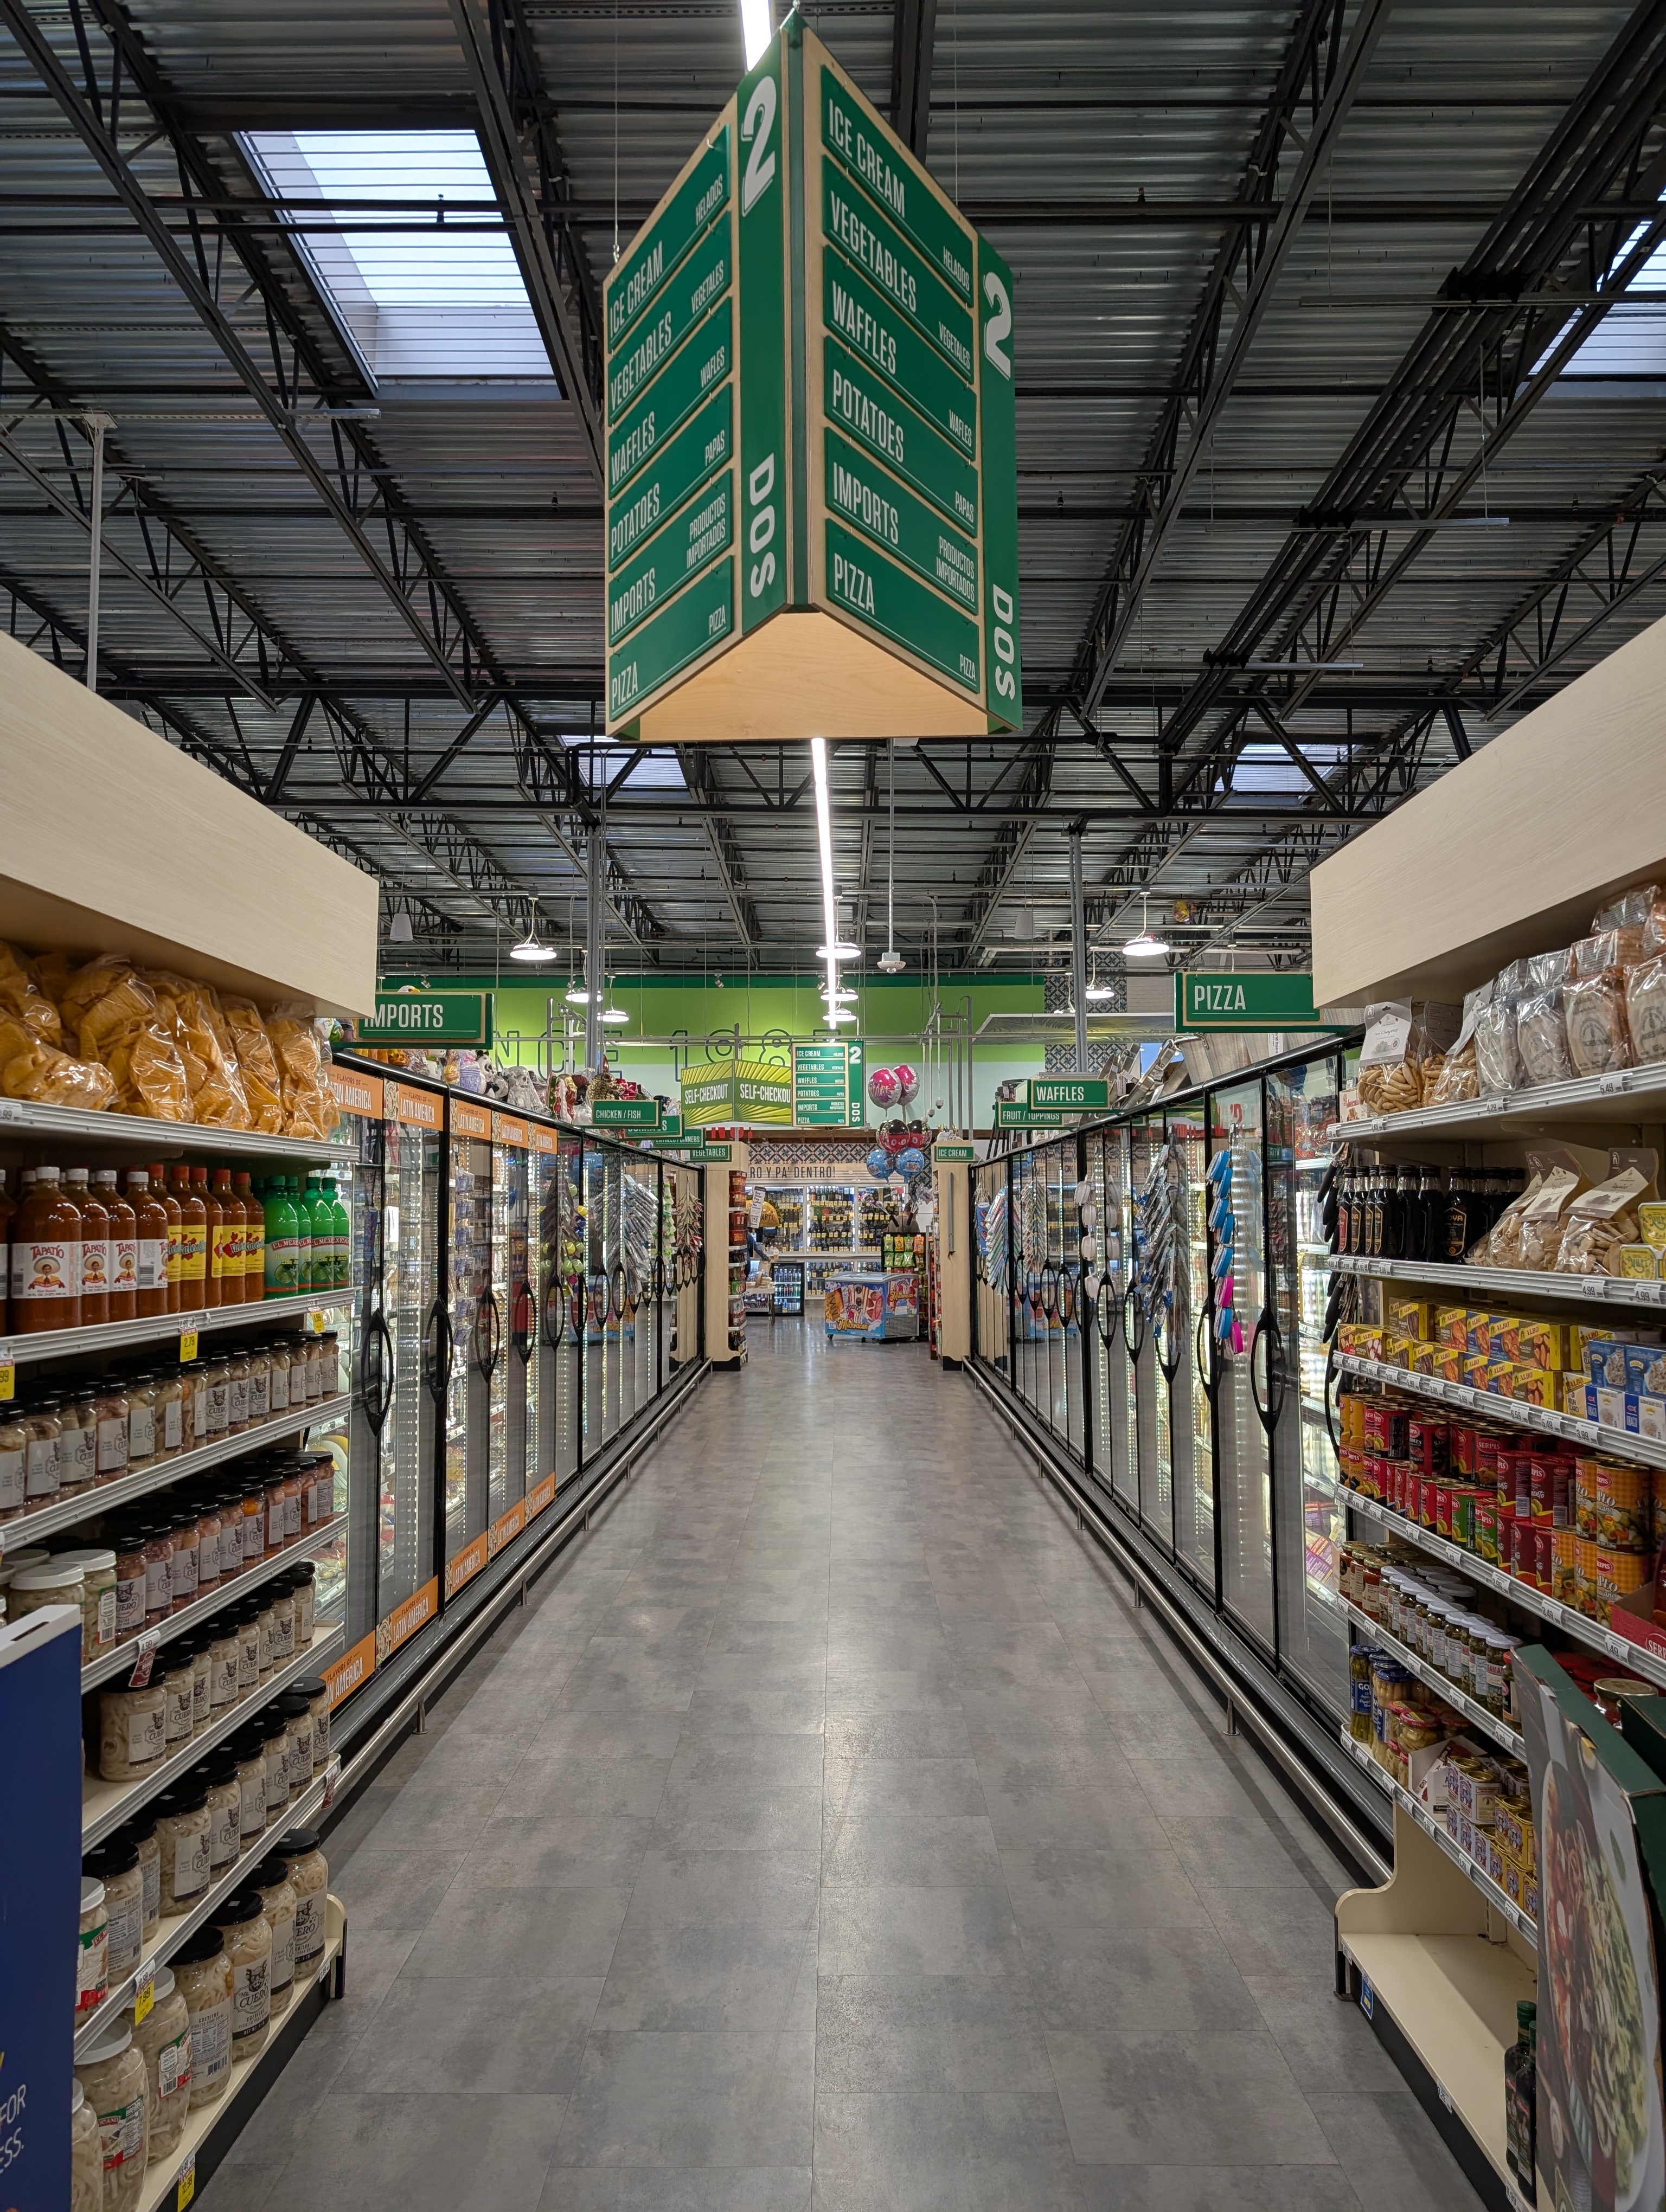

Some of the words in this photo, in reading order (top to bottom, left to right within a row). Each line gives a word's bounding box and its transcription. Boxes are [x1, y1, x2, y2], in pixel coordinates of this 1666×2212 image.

[741, 75, 776, 216] 2
[829, 99, 852, 159] ICE
[857, 133, 905, 218] CREAM
[696, 173, 722, 226] HELADOS
[830, 190, 917, 312] VEGETABLES
[943, 246, 970, 291] HELADOS
[611, 292, 625, 338] ICE
[627, 241, 663, 318] CREAM
[691, 260, 724, 314] VEGETALES
[832, 280, 896, 376] WAFFLES
[984, 272, 1011, 379] 2
[939, 321, 970, 369] VEGETALES
[611, 311, 671, 411] VEGETABLES
[700, 346, 725, 388] WAFLES
[832, 369, 904, 464] POTATOES
[949, 409, 972, 448] WAFLES
[611, 411, 655, 485] WAFFLES
[705, 430, 725, 466] PAPAS
[833, 461, 899, 545] IMPORTS
[955, 491, 974, 523] PAPAS
[611, 482, 659, 563] POTATOES
[689, 492, 725, 543] PRODUCTOS
[749, 453, 775, 598] DOS
[687, 519, 726, 569] IMPORTADOS
[939, 536, 975, 580] PRODUCTOS
[834, 552, 875, 616] PIZZA
[935, 557, 975, 602] IMPORTADOS
[611, 567, 655, 635] IMPORTS
[709, 605, 726, 635] PIZZA
[993, 583, 1015, 700] DOS
[959, 654, 976, 681] PIZZA
[612, 661, 638, 711] PIZZA
[1195, 985, 1246, 1010] PIZZA
[849, 1046, 861, 1064] 2
[337, 1073, 355, 1085] FLAVORS
[1600, 1083, 1614, 1094] 5.49
[345, 1086, 371, 1111] AMERICA
[408, 1092, 422, 1102] FLAVORS
[685, 1083, 728, 1105] SELF-CHECKOUT
[740, 1083, 792, 1104] SELF-CHECKOU
[1036, 1086, 1084, 1101] WAFFLES
[400, 1098, 413, 1118] LATIN
[414, 1103, 435, 1124] AMERICA
[596, 1110, 622, 1119] CHICKEN
[627, 1110, 641, 1119] FISH
[851, 1102, 860, 1122] DOS
[1003, 1111, 1022, 1120] FRUIT
[1486, 1103, 1497, 1113] 4.29
[692, 1148, 726, 1157] VEGETABLES
[766, 1167, 772, 1179] Y
[776, 1167, 790, 1179] PA'
[794, 1166, 835, 1178] DENTRO!
[1582, 1285, 1595, 1296] 4.99
[1635, 1290, 1650, 1301] 4.99
[1447, 1313, 1458, 1321] ALBO
[1471, 1317, 1481, 1326] ALBO
[1496, 1322, 1510, 1331] ALBO
[184, 1336, 195, 1348] 2.79
[1341, 1326, 1351, 1335] ALBO
[1362, 1333, 1374, 1341] ALBO
[1526, 1327, 1539, 1336] ALBO
[1585, 1330, 1599, 1341] ALBO
[1469, 1359, 1479, 1368] ALBO
[1494, 1365, 1505, 1374] ALBO
[1520, 1372, 1533, 1381] ALBO
[1541, 1419, 1553, 1430] 5.49
[1576, 1429, 1590, 1441] 3.99
[497, 1527, 505, 1546] LATIN
[506, 1514, 520, 1539] AMERICA
[453, 1567, 463, 1587] LATIN
[463, 1549, 480, 1580] AMERICA
[401, 1598, 415, 1617] FLAVORS
[416, 1595, 420, 1604] OF
[1542, 1606, 1554, 1620] 3.49
[393, 1617, 407, 1644] LATIN
[408, 1597, 428, 1632] AMERICA
[1606, 1642, 1619, 1657] 1.49
[327, 1664, 345, 1682] FLAVORS
[347, 1656, 353, 1667] OF
[335, 1656, 363, 1699] AMERICA
[292, 1750, 312, 1765] CUERO
[139, 1986, 150, 2008] 7.99
[240, 1985, 268, 2008] CUERO
